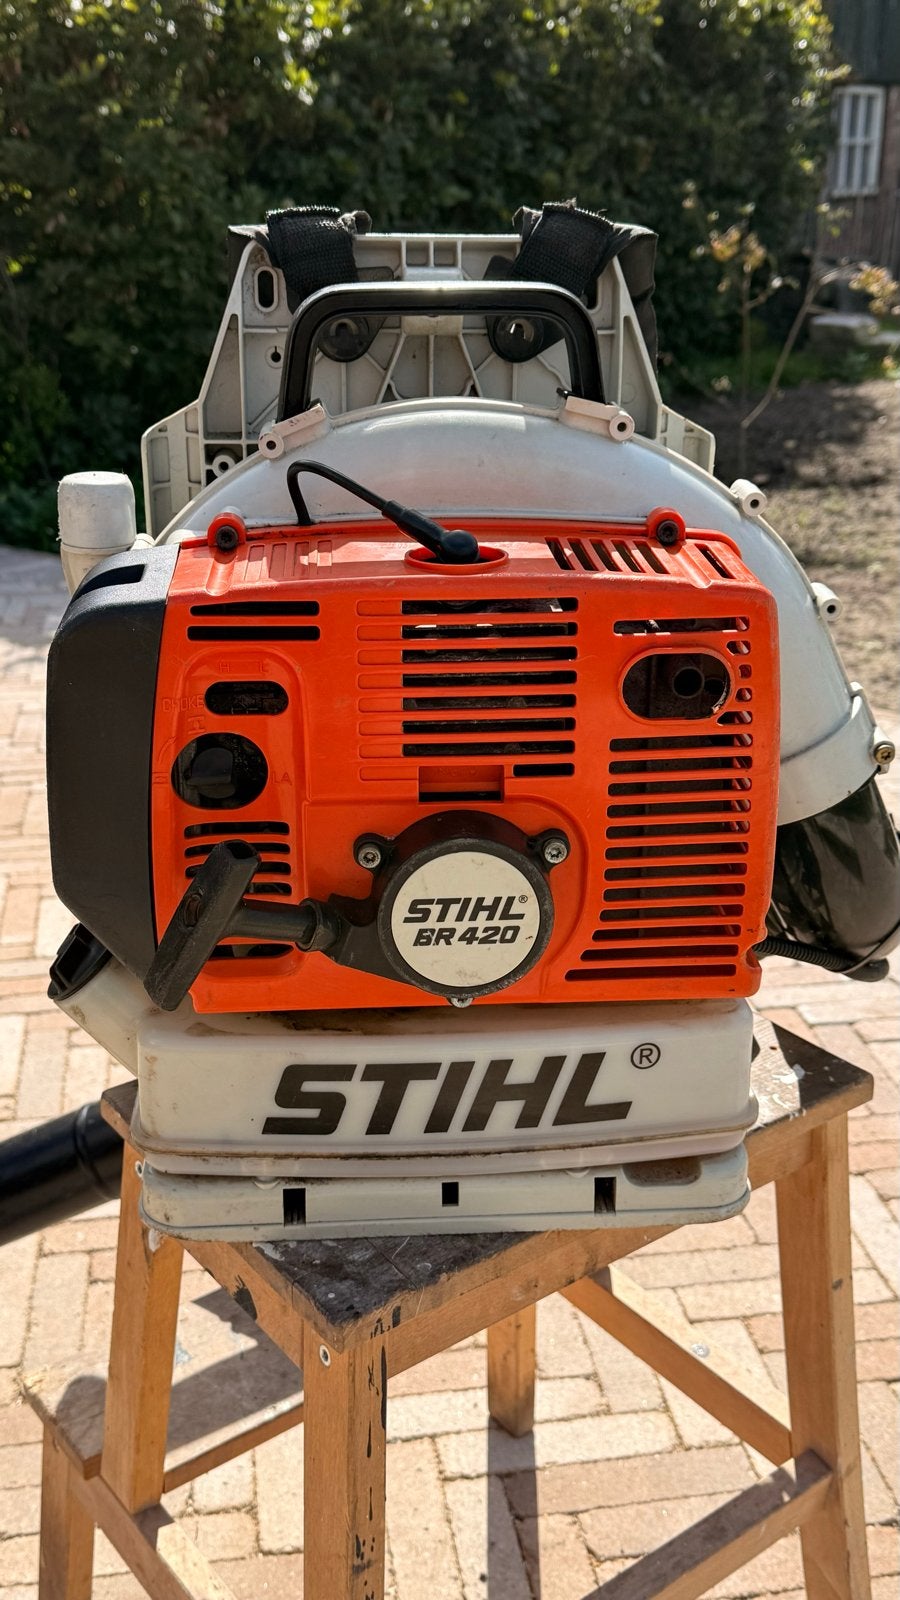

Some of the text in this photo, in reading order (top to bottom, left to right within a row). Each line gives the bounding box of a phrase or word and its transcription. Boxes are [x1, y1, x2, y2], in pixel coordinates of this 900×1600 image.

[162, 694, 205, 713] CHOKE
[412, 925, 521, 947] BR 420
